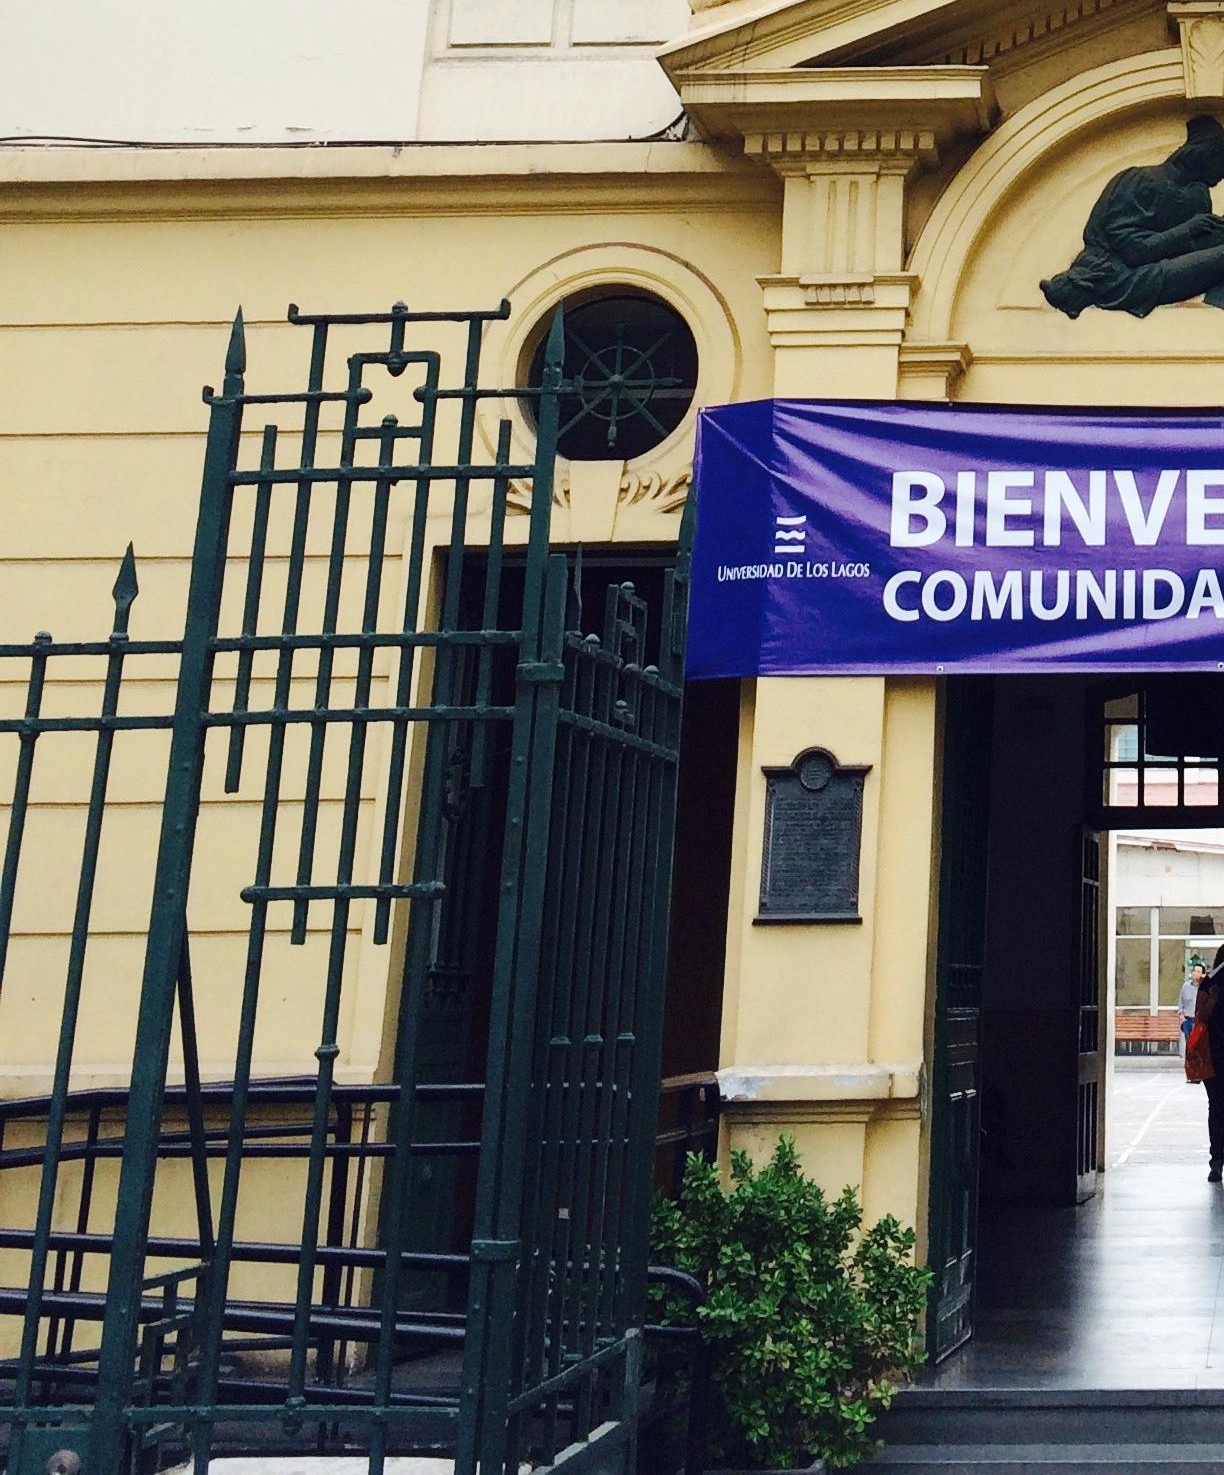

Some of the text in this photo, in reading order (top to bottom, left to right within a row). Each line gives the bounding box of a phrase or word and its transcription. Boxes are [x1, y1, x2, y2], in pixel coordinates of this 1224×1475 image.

[718, 561, 870, 582] UNIVERSIDAD DE LOS LAGOS
